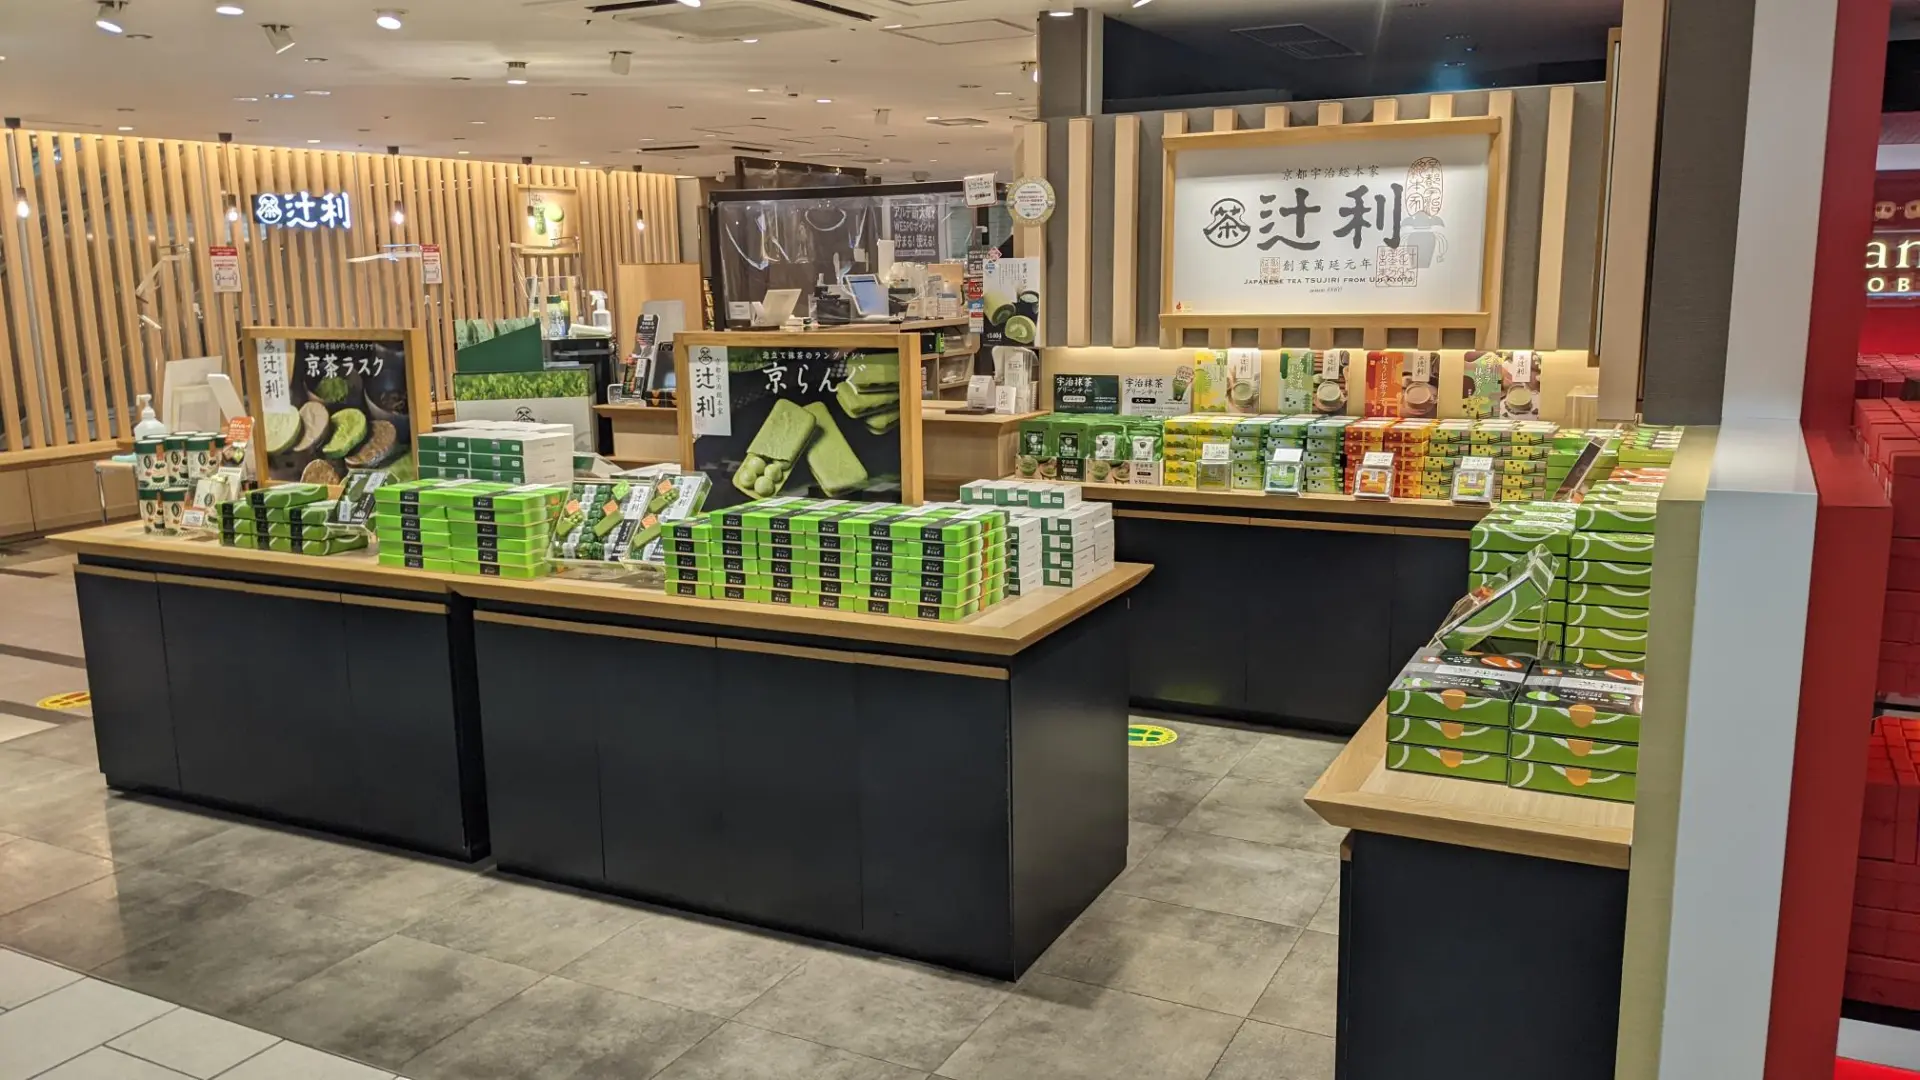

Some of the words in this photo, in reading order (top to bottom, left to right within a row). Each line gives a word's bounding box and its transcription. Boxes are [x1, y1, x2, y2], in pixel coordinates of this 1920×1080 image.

[1281, 164, 1380, 181] 京都宇治総本家
[284, 191, 351, 228] 辻利
[1257, 183, 1403, 250] 辻利
[263, 355, 279, 398] 辻利
[304, 353, 384, 378] 京茶ラスク
[763, 362, 867, 395] 京らんぐ
[1056, 376, 1093, 387] 宇治抹茶
[696, 367, 715, 418] 辻利
[1125, 378, 1163, 388] 宇治抹茶
